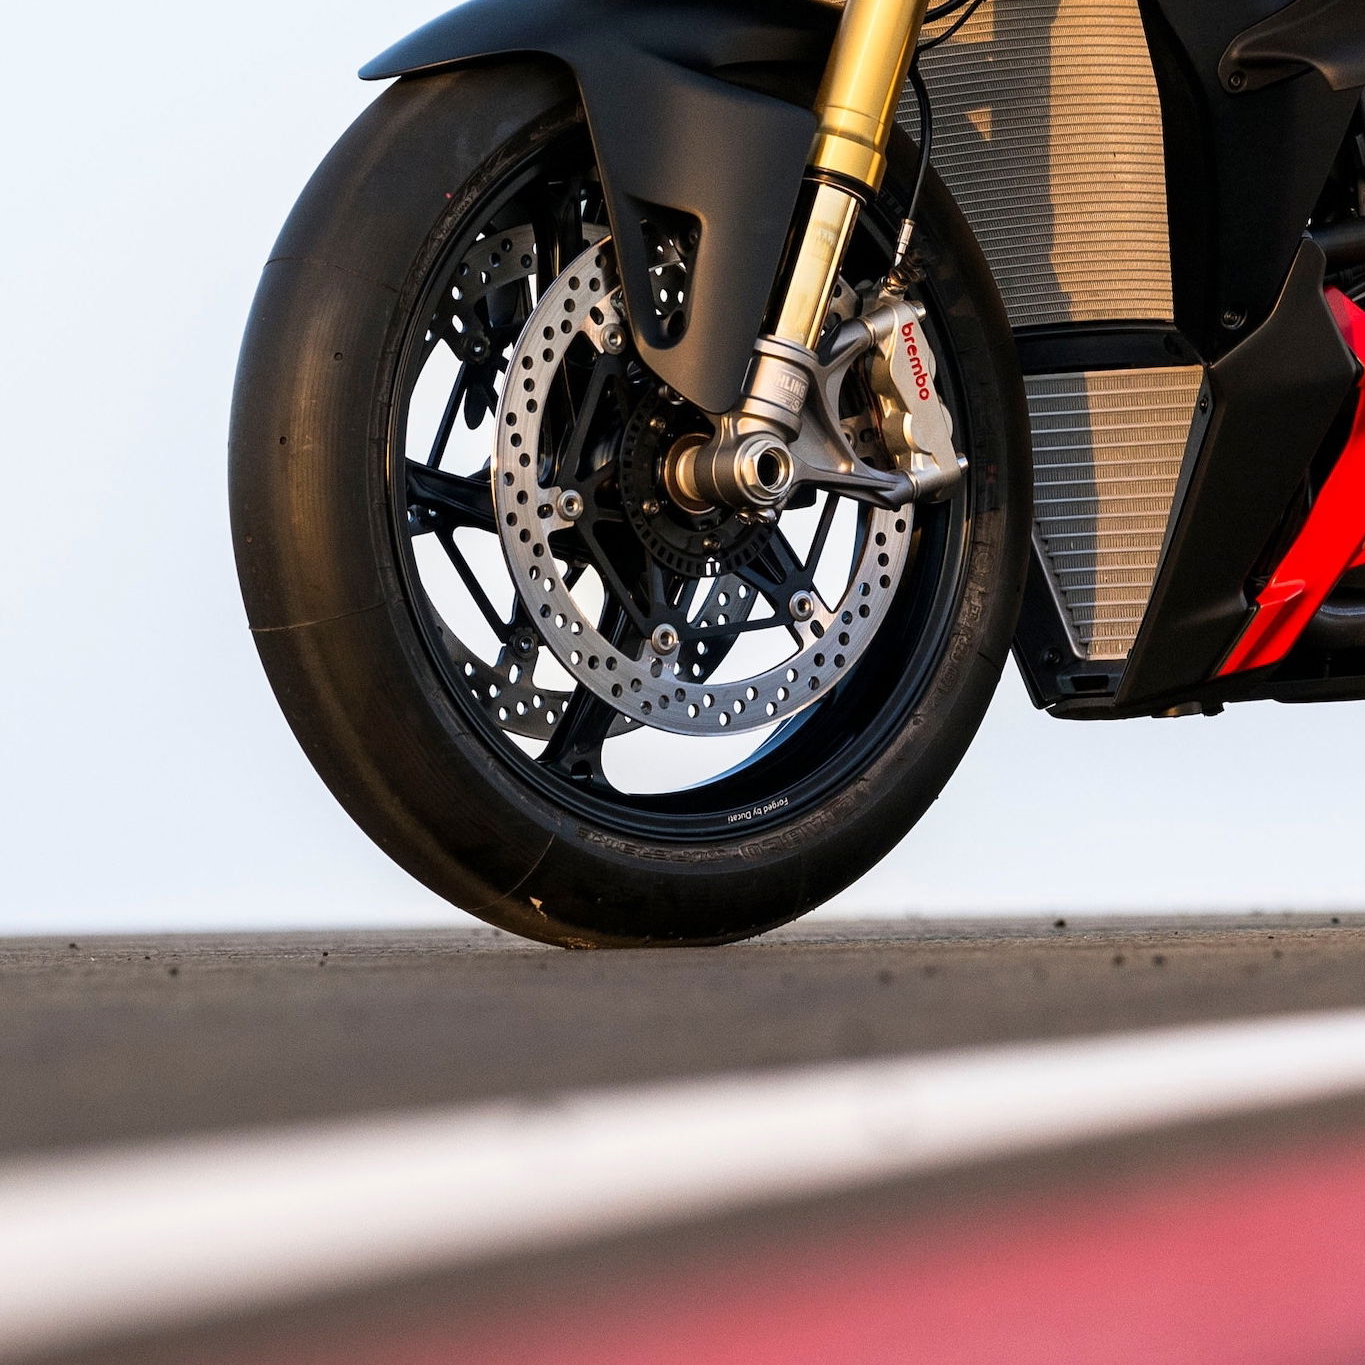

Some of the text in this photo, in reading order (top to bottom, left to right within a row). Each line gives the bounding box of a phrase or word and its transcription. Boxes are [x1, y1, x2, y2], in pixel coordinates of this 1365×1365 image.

[901, 322, 930, 400] brembo
[727, 796, 789, 824] Forged by Ducati
